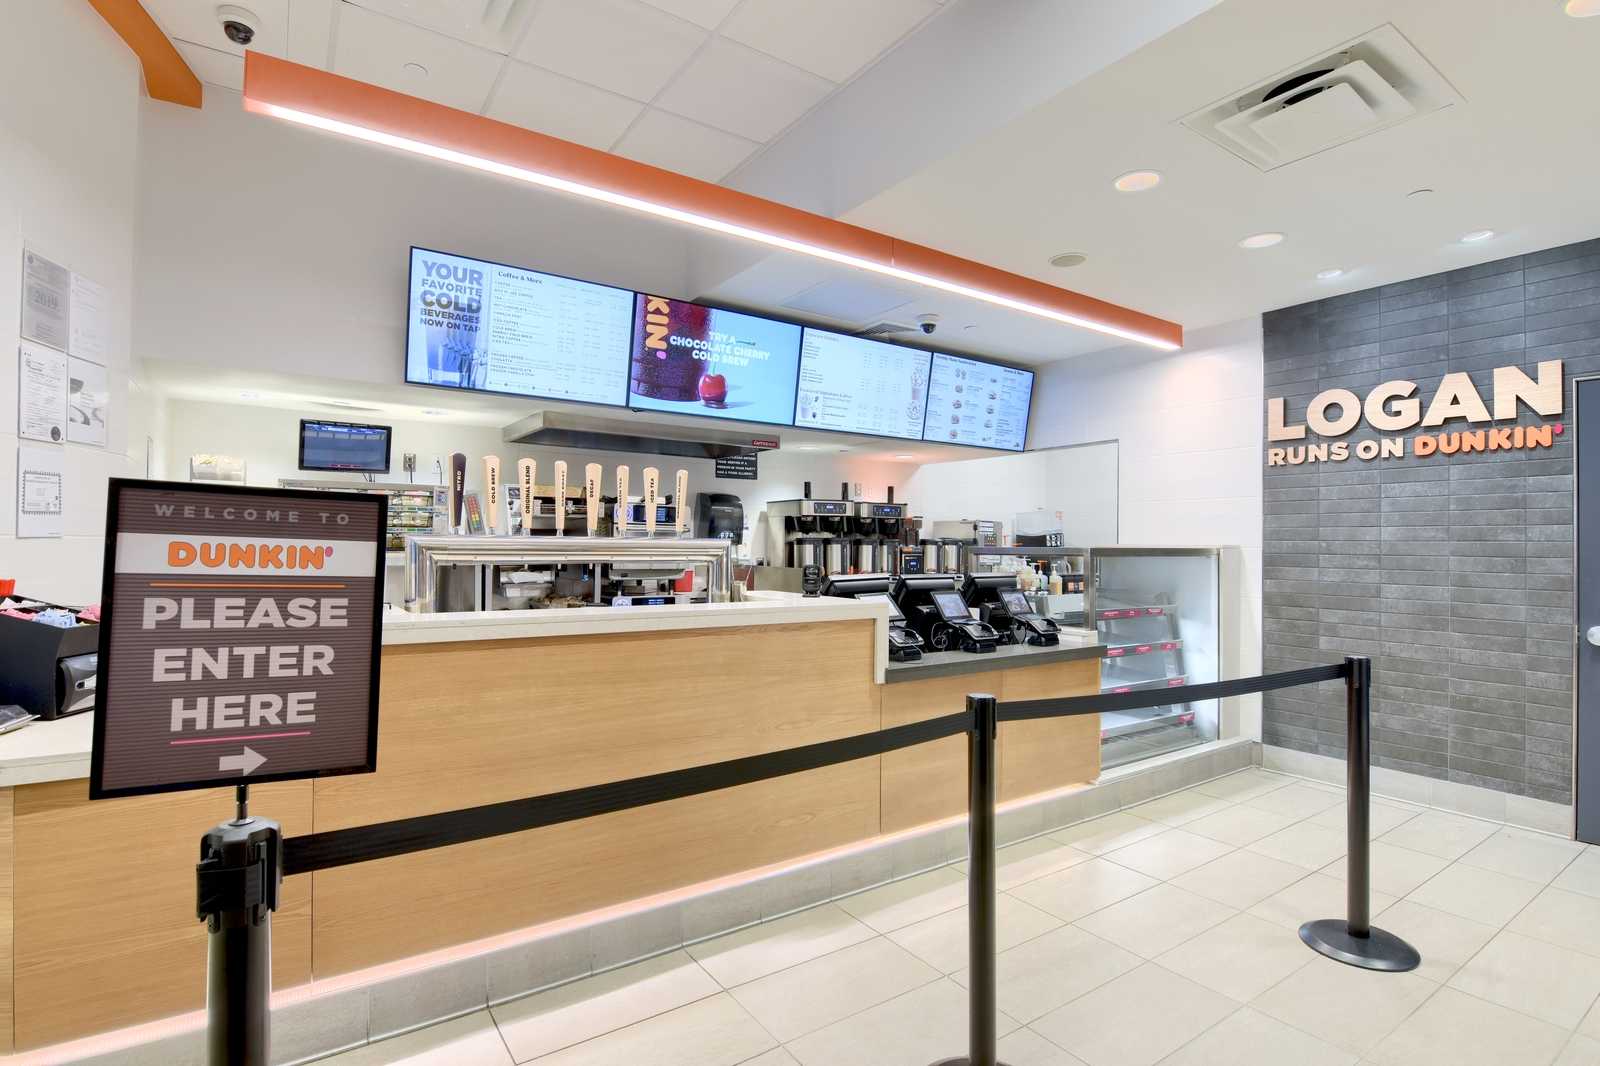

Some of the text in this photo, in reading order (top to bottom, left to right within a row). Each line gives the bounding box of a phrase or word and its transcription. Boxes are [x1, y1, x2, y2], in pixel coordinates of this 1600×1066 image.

[422, 260, 483, 286] YOUR
[498, 271, 520, 281] Coffee
[421, 279, 483, 297] FAVORITE
[420, 290, 482, 314] COLD
[420, 308, 481, 324] BEVERAGES
[420, 317, 481, 333] NOW ON TAP
[669, 335, 771, 361] CHOCOLATE CHERRY
[709, 331, 737, 345] TRY A
[692, 349, 751, 367] COLD BREW
[1267, 359, 1563, 441] LOGAN
[1268, 441, 1349, 466] RUNS
[1355, 437, 1405, 460] ON
[154, 503, 350, 525] WELCOME TO
[167, 541, 333, 570] DUNKIN'
[141, 597, 349, 630] PLEASE
[152, 644, 335, 682] ENTER
[170, 691, 317, 732] HERE
